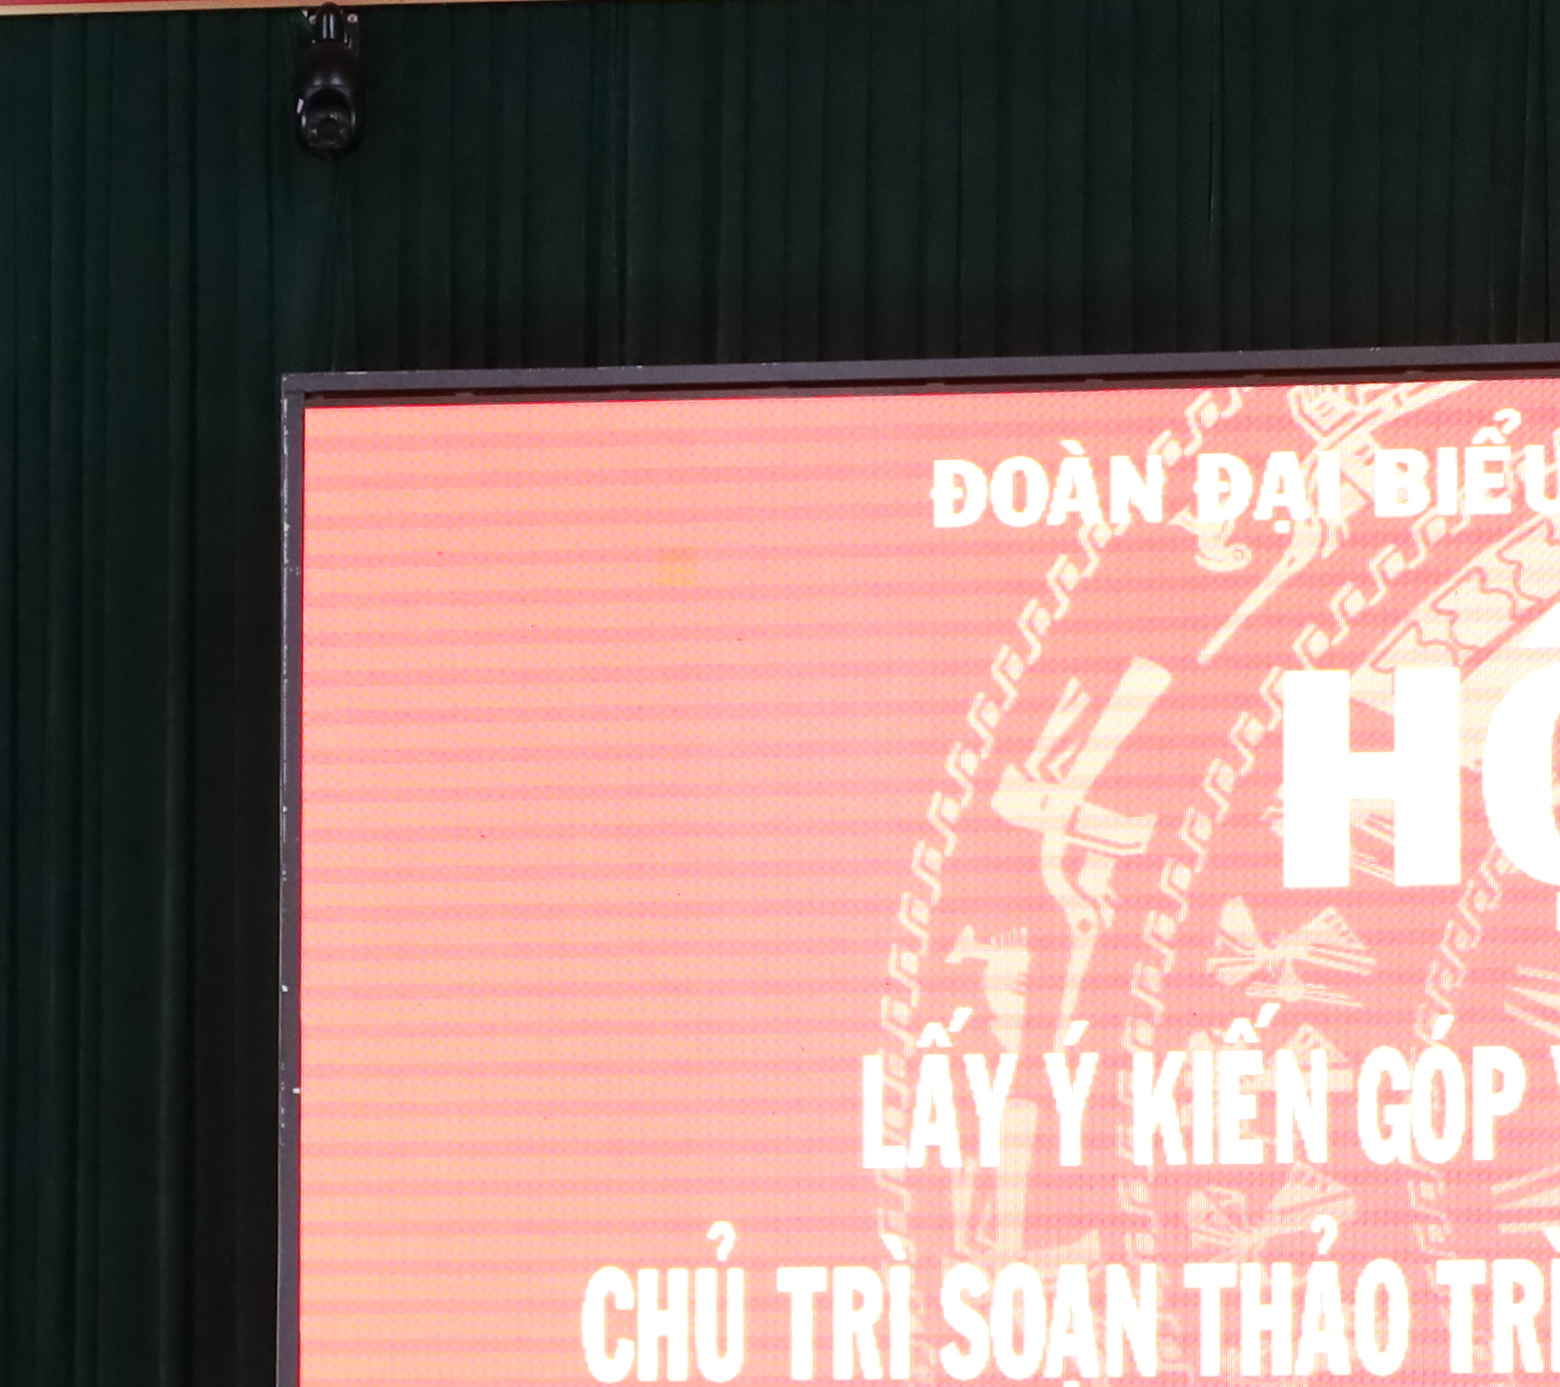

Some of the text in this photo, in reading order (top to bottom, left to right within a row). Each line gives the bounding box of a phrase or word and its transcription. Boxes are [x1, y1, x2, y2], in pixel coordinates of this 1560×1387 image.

[930, 441, 1164, 528] ĐOÀN
[1193, 450, 1342, 534] ĐẠI
[862, 1007, 1018, 1169] LẤY
[1044, 1021, 1098, 1167] Ý
[1132, 1003, 1328, 1166] KIẾN
[1358, 1015, 1525, 1165] GÓP
[582, 1222, 744, 1383] CHỦ
[776, 1235, 911, 1381] TRÌ
[1184, 1214, 1409, 1377] THẢO
